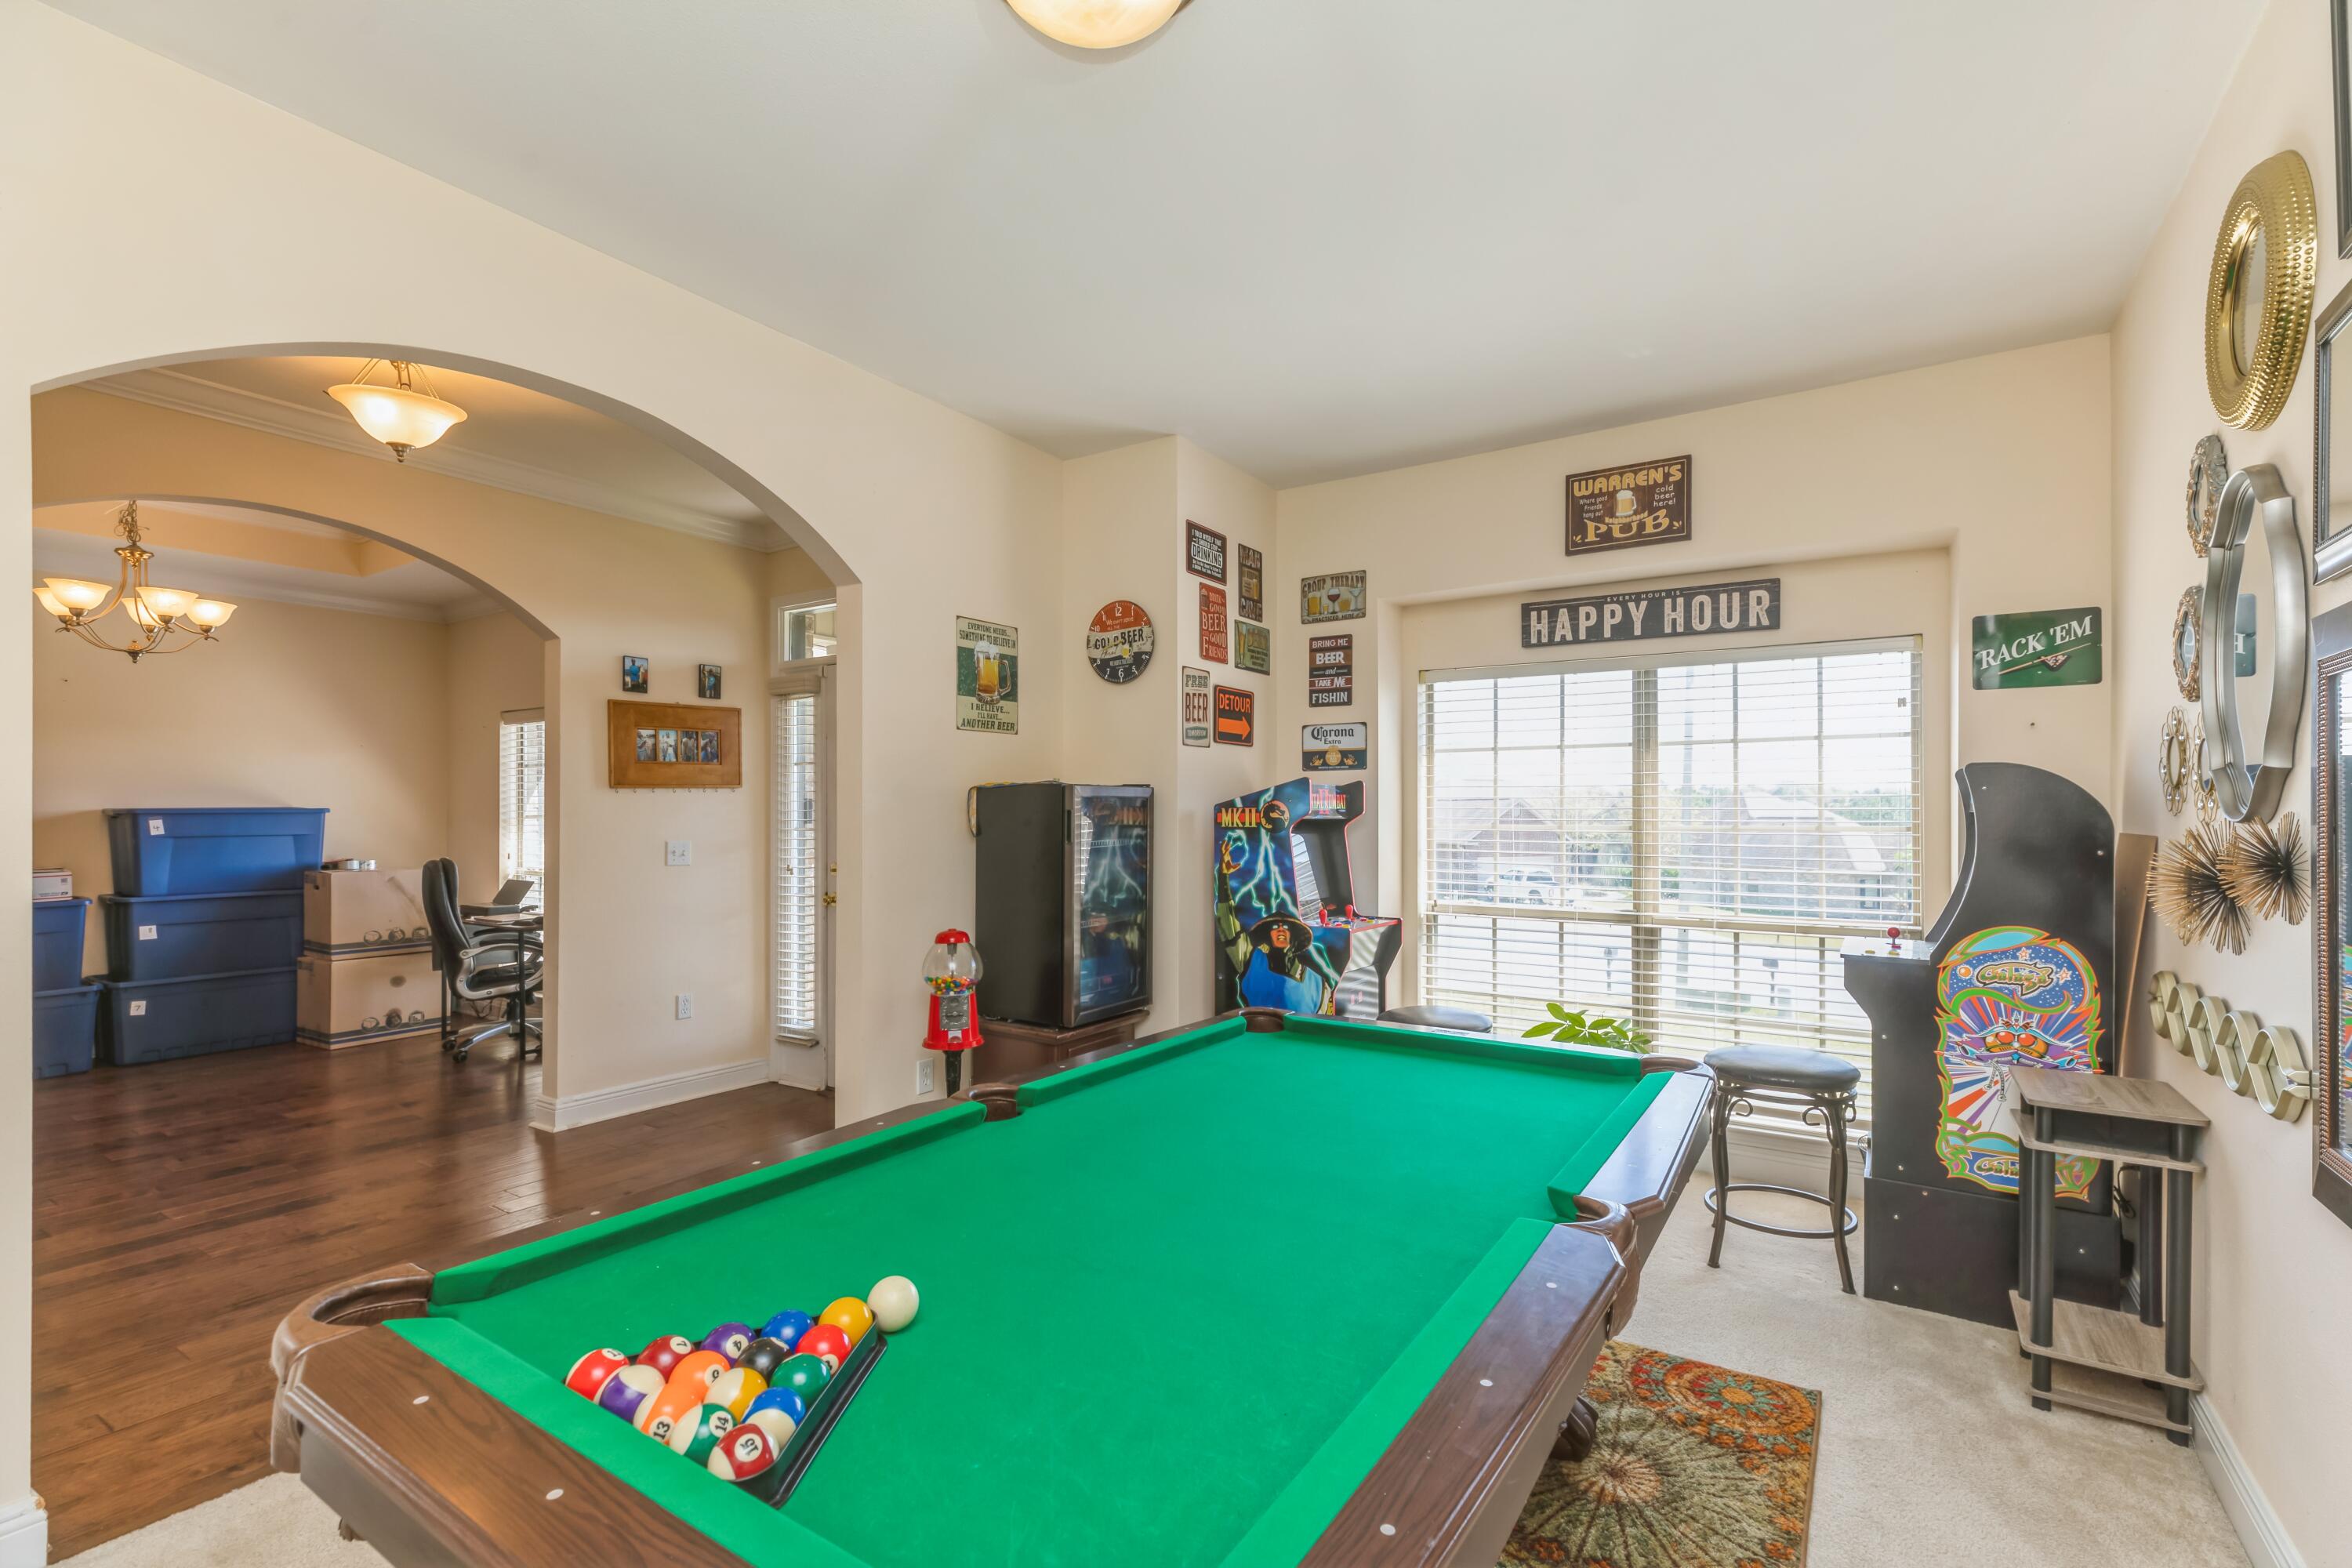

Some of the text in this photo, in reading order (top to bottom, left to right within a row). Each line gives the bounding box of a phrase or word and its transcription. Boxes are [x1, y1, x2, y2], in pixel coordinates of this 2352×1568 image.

[1573, 464, 1682, 497] WARREN'S
[1654, 492, 1675, 500] beer
[1656, 484, 1674, 493] cold
[1596, 495, 1608, 504] good
[1653, 498, 1675, 507] here!
[1584, 509, 1670, 542] PUB
[1192, 543, 1222, 568] DRINKING
[1302, 575, 1364, 597] GROUP THERAPY
[1115, 607, 1122, 617] 12
[1210, 602, 1225, 616] GOOD
[1530, 589, 1770, 644] HAPPY HOUR
[967, 622, 992, 634] EVERYONE
[1202, 612, 1226, 633] BEER
[960, 630, 1016, 649] SOMETHING TO BELIEVE IN
[1120, 628, 1145, 645] BEER
[1210, 633, 1226, 648] GOOD
[1312, 639, 1336, 648] BRING
[1980, 615, 2092, 670] RACK 'EM
[1203, 636, 1228, 660] FRIENDS
[1316, 652, 1345, 665] BEER
[1118, 668, 1124, 678] 6
[1185, 674, 1208, 688] FREE
[1315, 679, 1331, 688] TAKE
[1219, 693, 1250, 713] DETOUR
[1312, 691, 1348, 704] FISHIN
[1185, 692, 1208, 724] BEER
[960, 718, 1015, 731] ANOTHER BEER
[1311, 726, 1355, 742] Corona
[733, 1339, 742, 1352] 4
[653, 1421, 671, 1440] 13
[715, 1417, 729, 1433] 14
[740, 1438, 759, 1456] 15
